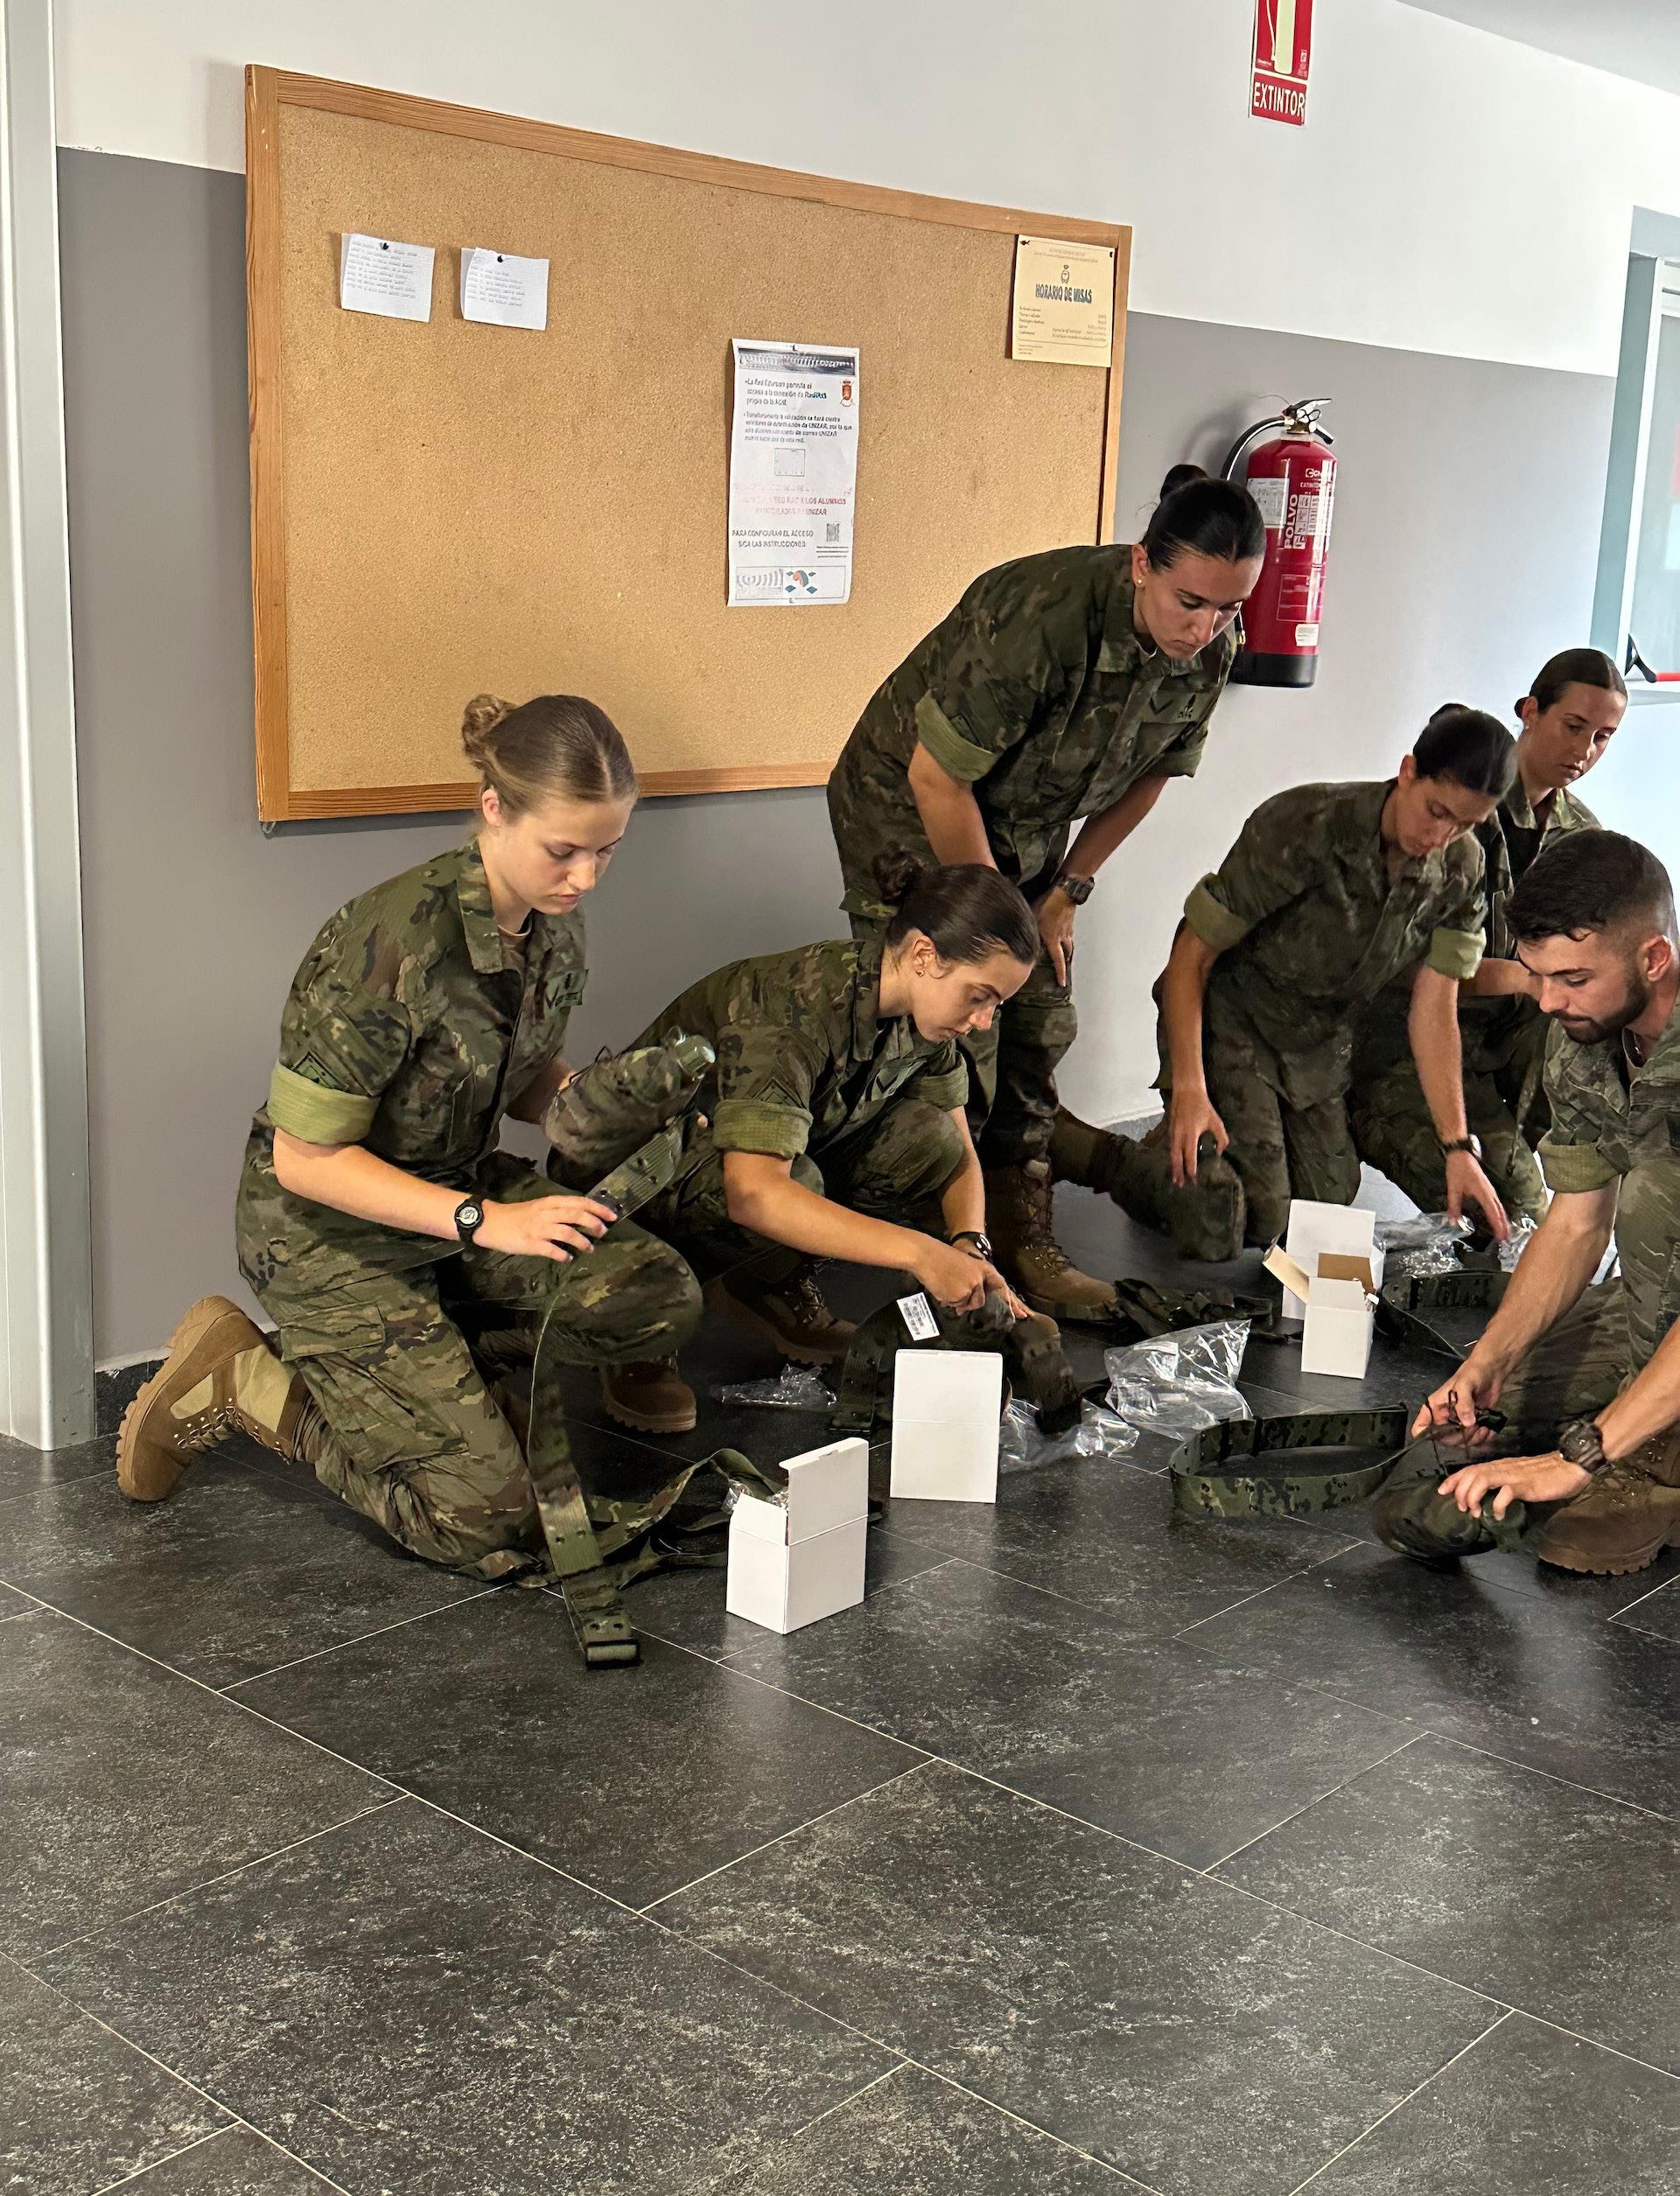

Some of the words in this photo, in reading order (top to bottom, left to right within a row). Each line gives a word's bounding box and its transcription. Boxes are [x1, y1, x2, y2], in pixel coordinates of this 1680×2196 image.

[1253, 82, 1306, 116] EXTINTOR
[1035, 283, 1063, 301] HORARIO
[1064, 286, 1073, 302] DE
[1073, 288, 1092, 304] MISAS
[1284, 493, 1298, 549] POLVO
